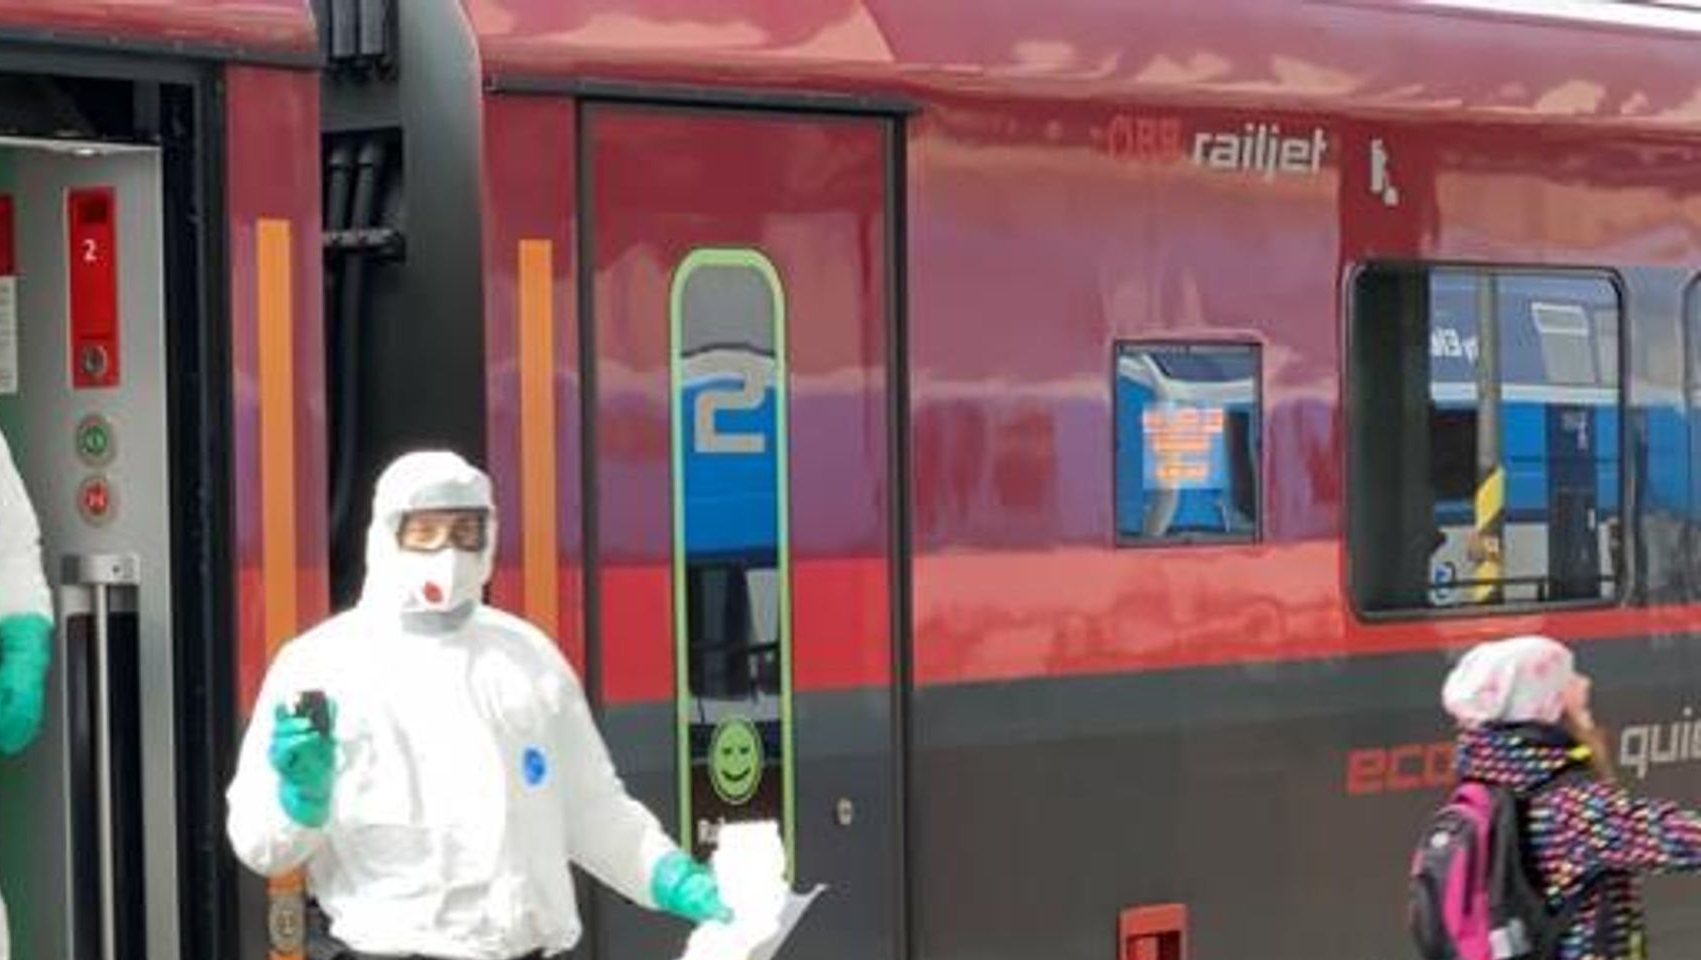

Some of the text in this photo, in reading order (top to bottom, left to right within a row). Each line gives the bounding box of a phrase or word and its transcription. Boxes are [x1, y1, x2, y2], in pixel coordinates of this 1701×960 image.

[1193, 123, 1328, 182] railjet
[82, 239, 98, 261] 2
[692, 352, 766, 453] 2
[1347, 741, 1456, 795] eco
